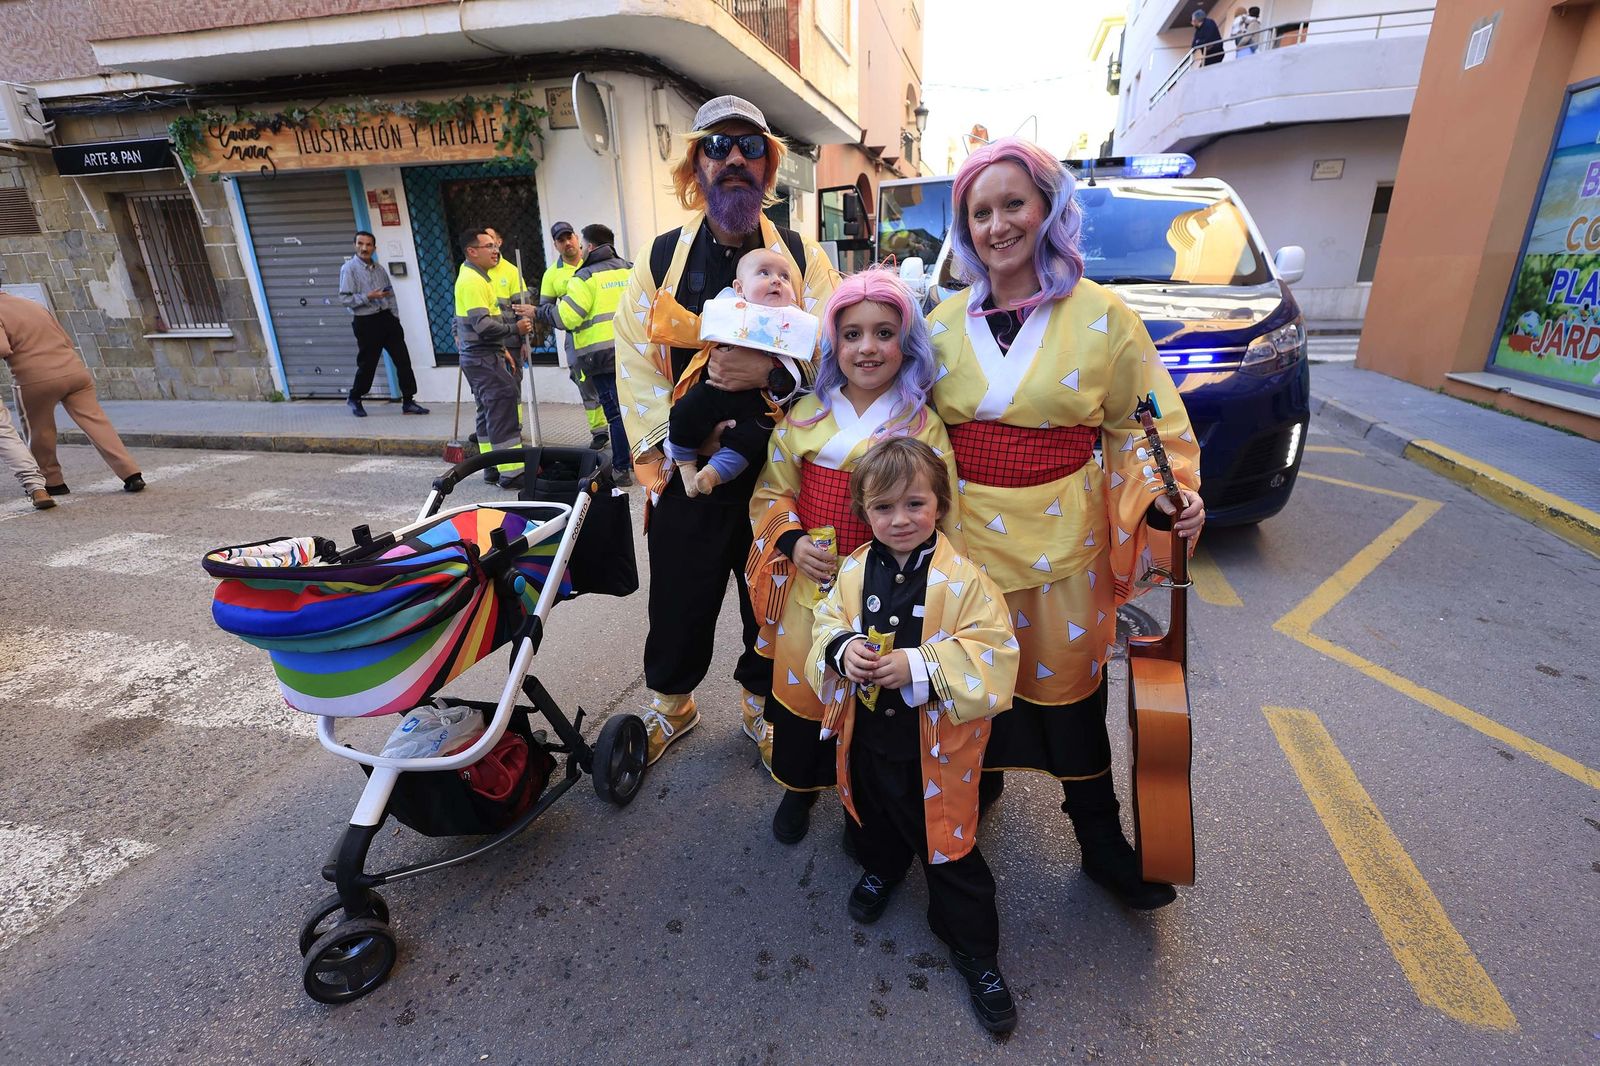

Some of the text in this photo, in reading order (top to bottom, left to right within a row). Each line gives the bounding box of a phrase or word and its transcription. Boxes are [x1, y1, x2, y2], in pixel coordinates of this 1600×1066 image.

[293, 117, 499, 155] ILUSTRACIÓN Y TATUAJE
[84, 149, 143, 167] ARTE & PAN
[600, 279, 633, 290] LIMPIEZ
[1546, 268, 1600, 307] PLA
[1531, 320, 1600, 362] JARD
[571, 502, 588, 541] COSATTO
